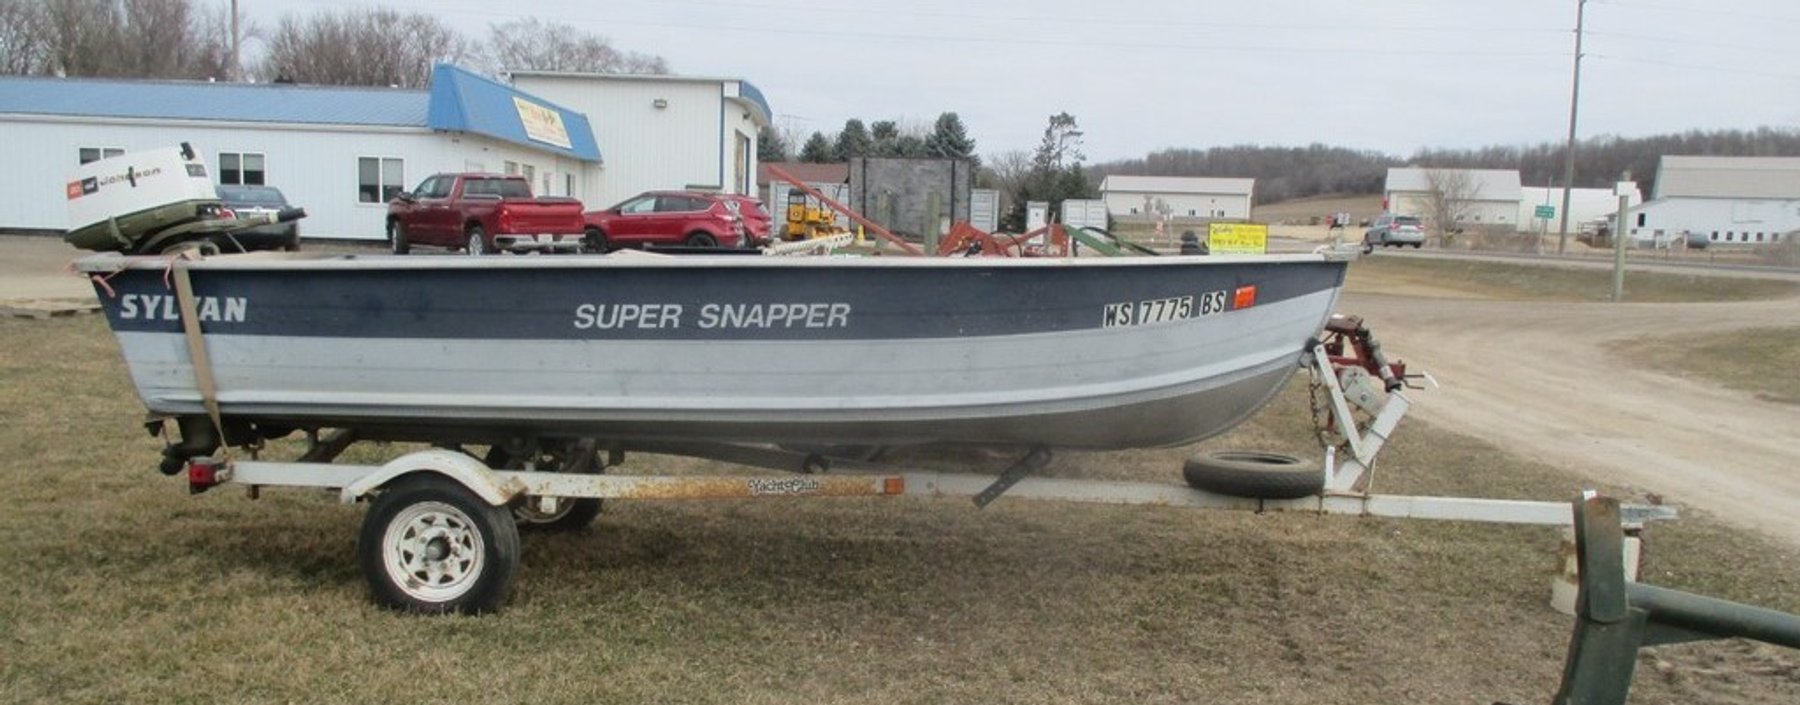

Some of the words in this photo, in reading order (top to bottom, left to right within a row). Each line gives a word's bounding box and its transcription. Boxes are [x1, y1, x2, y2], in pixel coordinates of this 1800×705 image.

[574, 303, 683, 329] SUPER
[697, 303, 851, 329] SNAPPER
[1105, 303, 1132, 326] WS
[1142, 297, 1190, 323] 7775
[1202, 292, 1225, 315] BS
